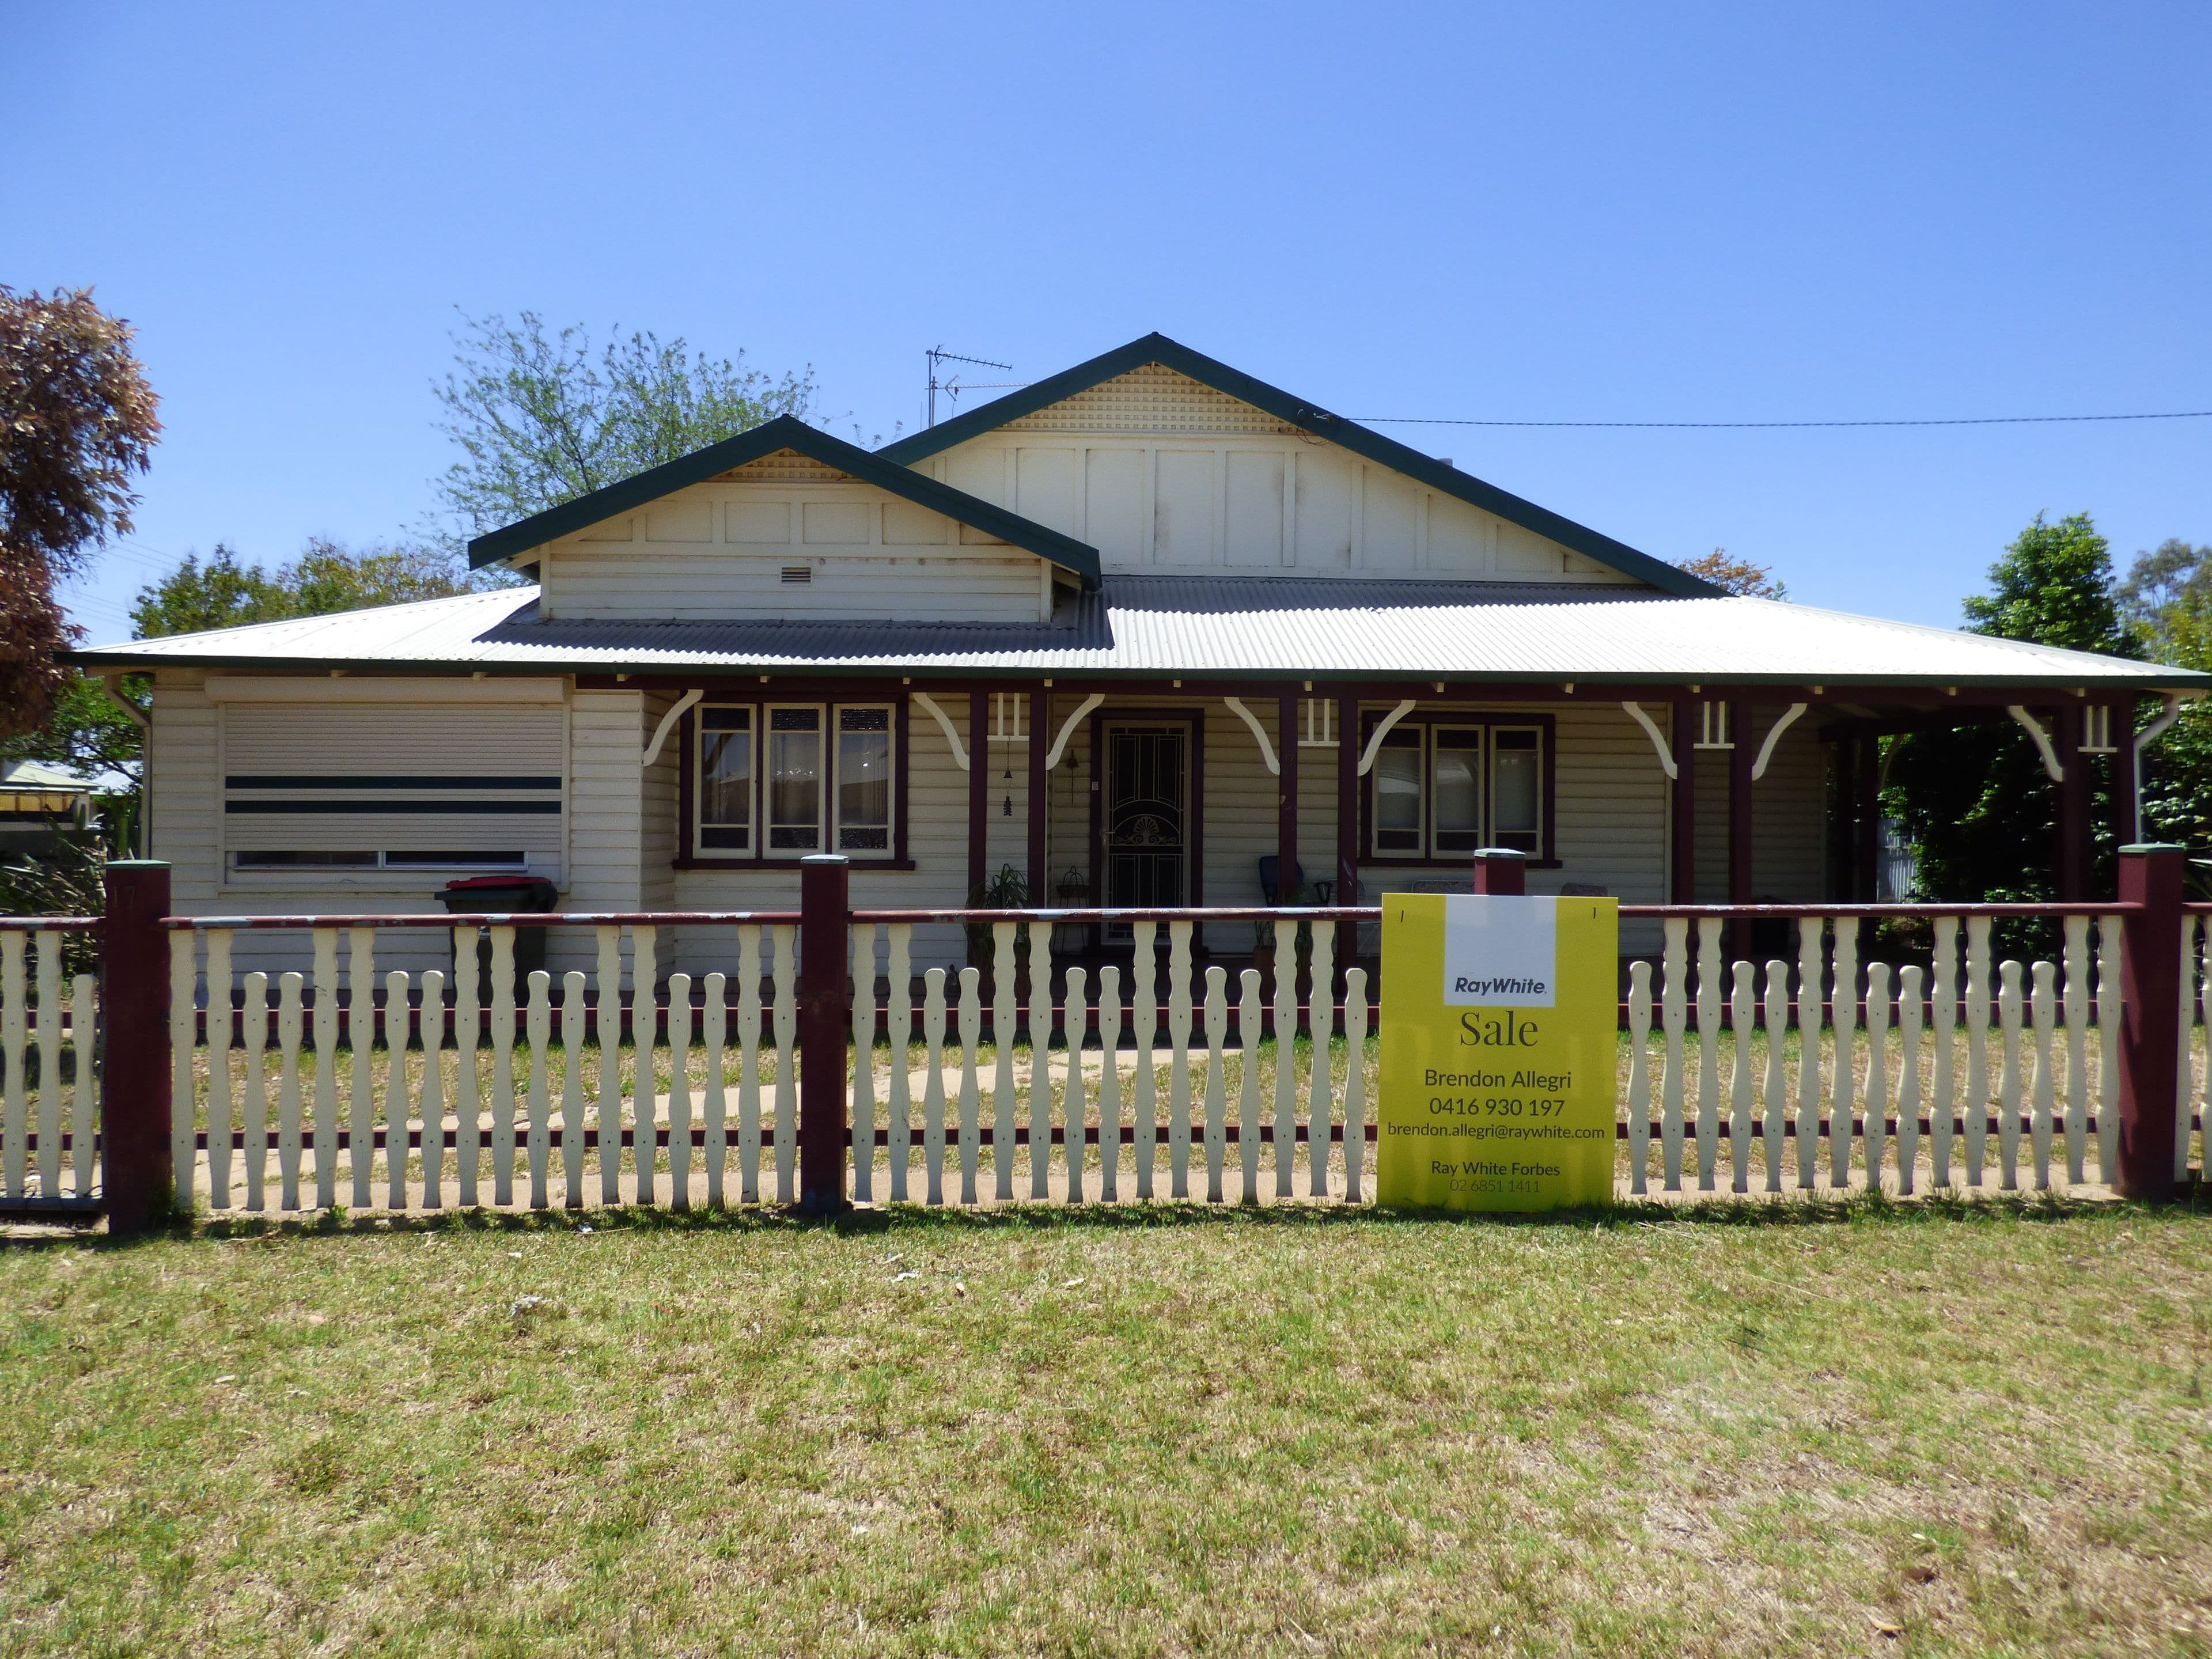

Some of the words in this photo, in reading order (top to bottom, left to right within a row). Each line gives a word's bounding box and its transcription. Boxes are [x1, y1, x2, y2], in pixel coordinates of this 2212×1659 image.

[1460, 1010, 1538, 1047] Sale
[1425, 1069, 1505, 1087] Brendon
[1511, 1070, 1571, 1092] Allegri
[1429, 1097, 1480, 1115] 0416
[1485, 1099, 1522, 1116] 930
[1529, 1099, 1565, 1116] 197
[1388, 1122, 1605, 1141] brendon.allegri@raywhite.com
[1431, 1161, 1459, 1177] Ray
[1463, 1161, 1507, 1176] White
[1512, 1162, 1560, 1176] Forbes
[1450, 1179, 1467, 1192] 02
[1471, 1180, 1504, 1192] 6851
[1509, 1180, 1540, 1193] 1411
